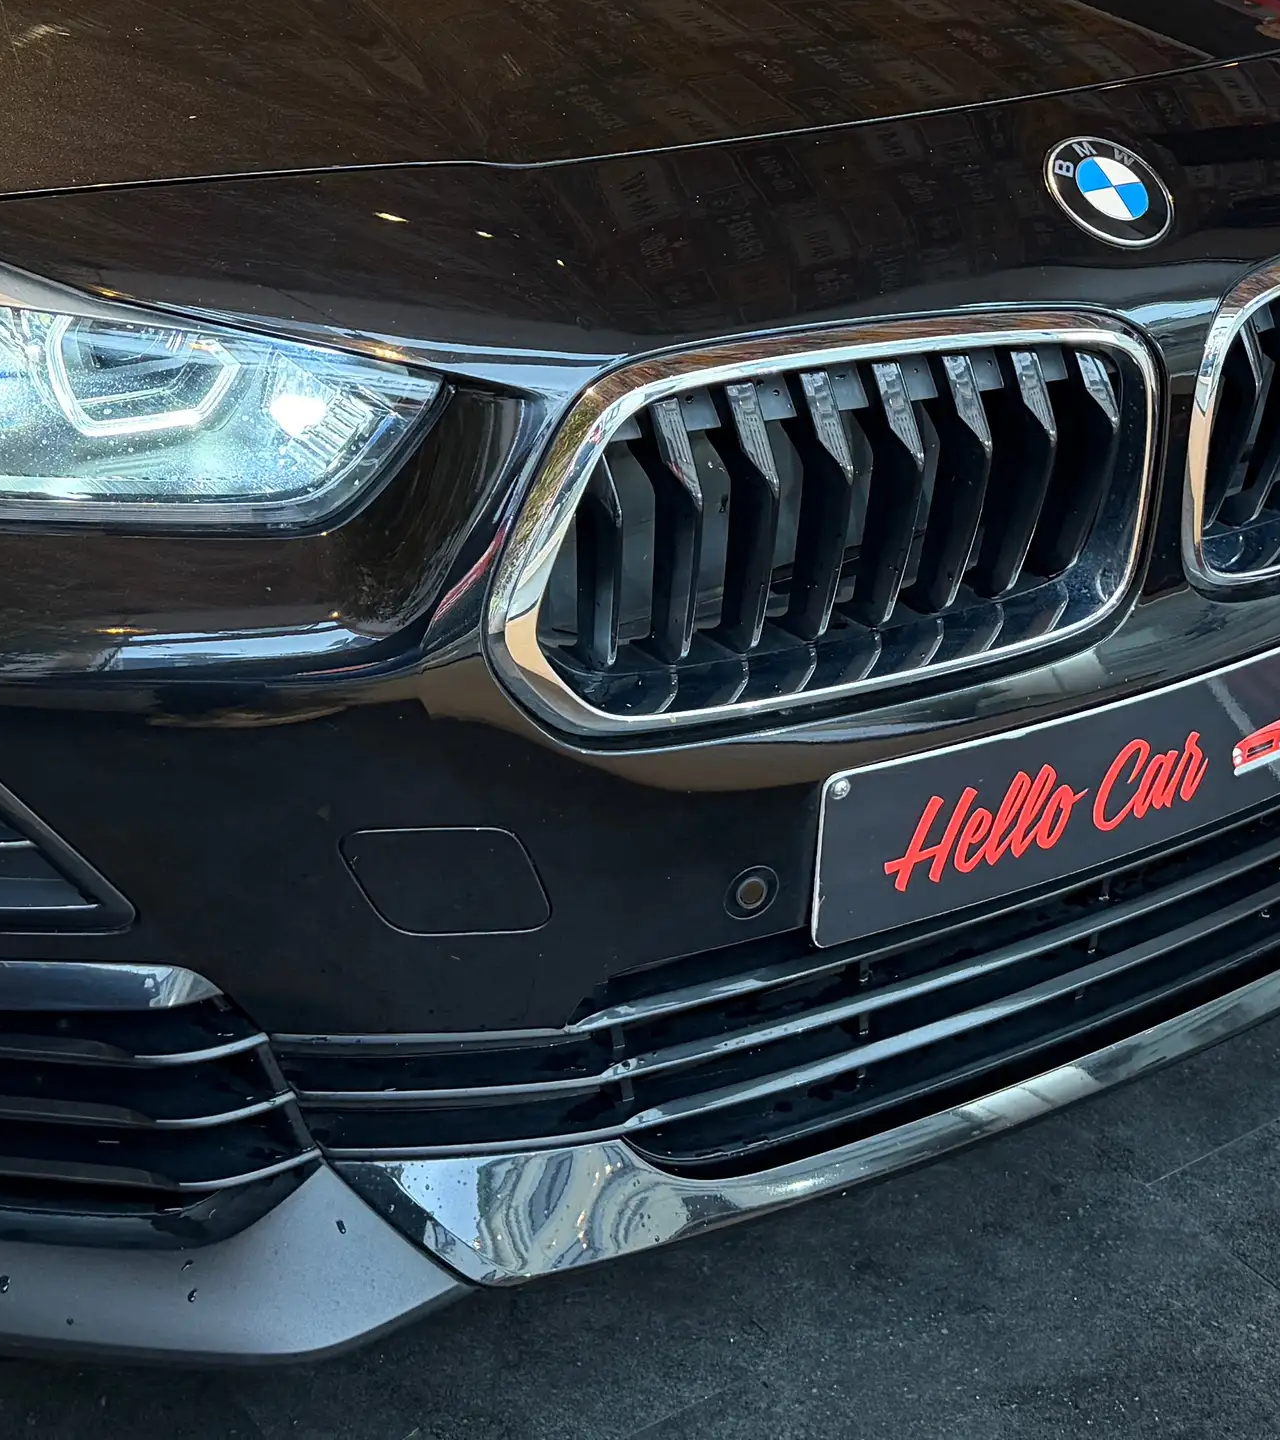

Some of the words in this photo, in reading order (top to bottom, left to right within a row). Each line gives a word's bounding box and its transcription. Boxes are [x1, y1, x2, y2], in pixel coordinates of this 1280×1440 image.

[1054, 140, 1135, 179] BMW
[884, 763, 1088, 893] Hello
[1093, 730, 1209, 832] Car
